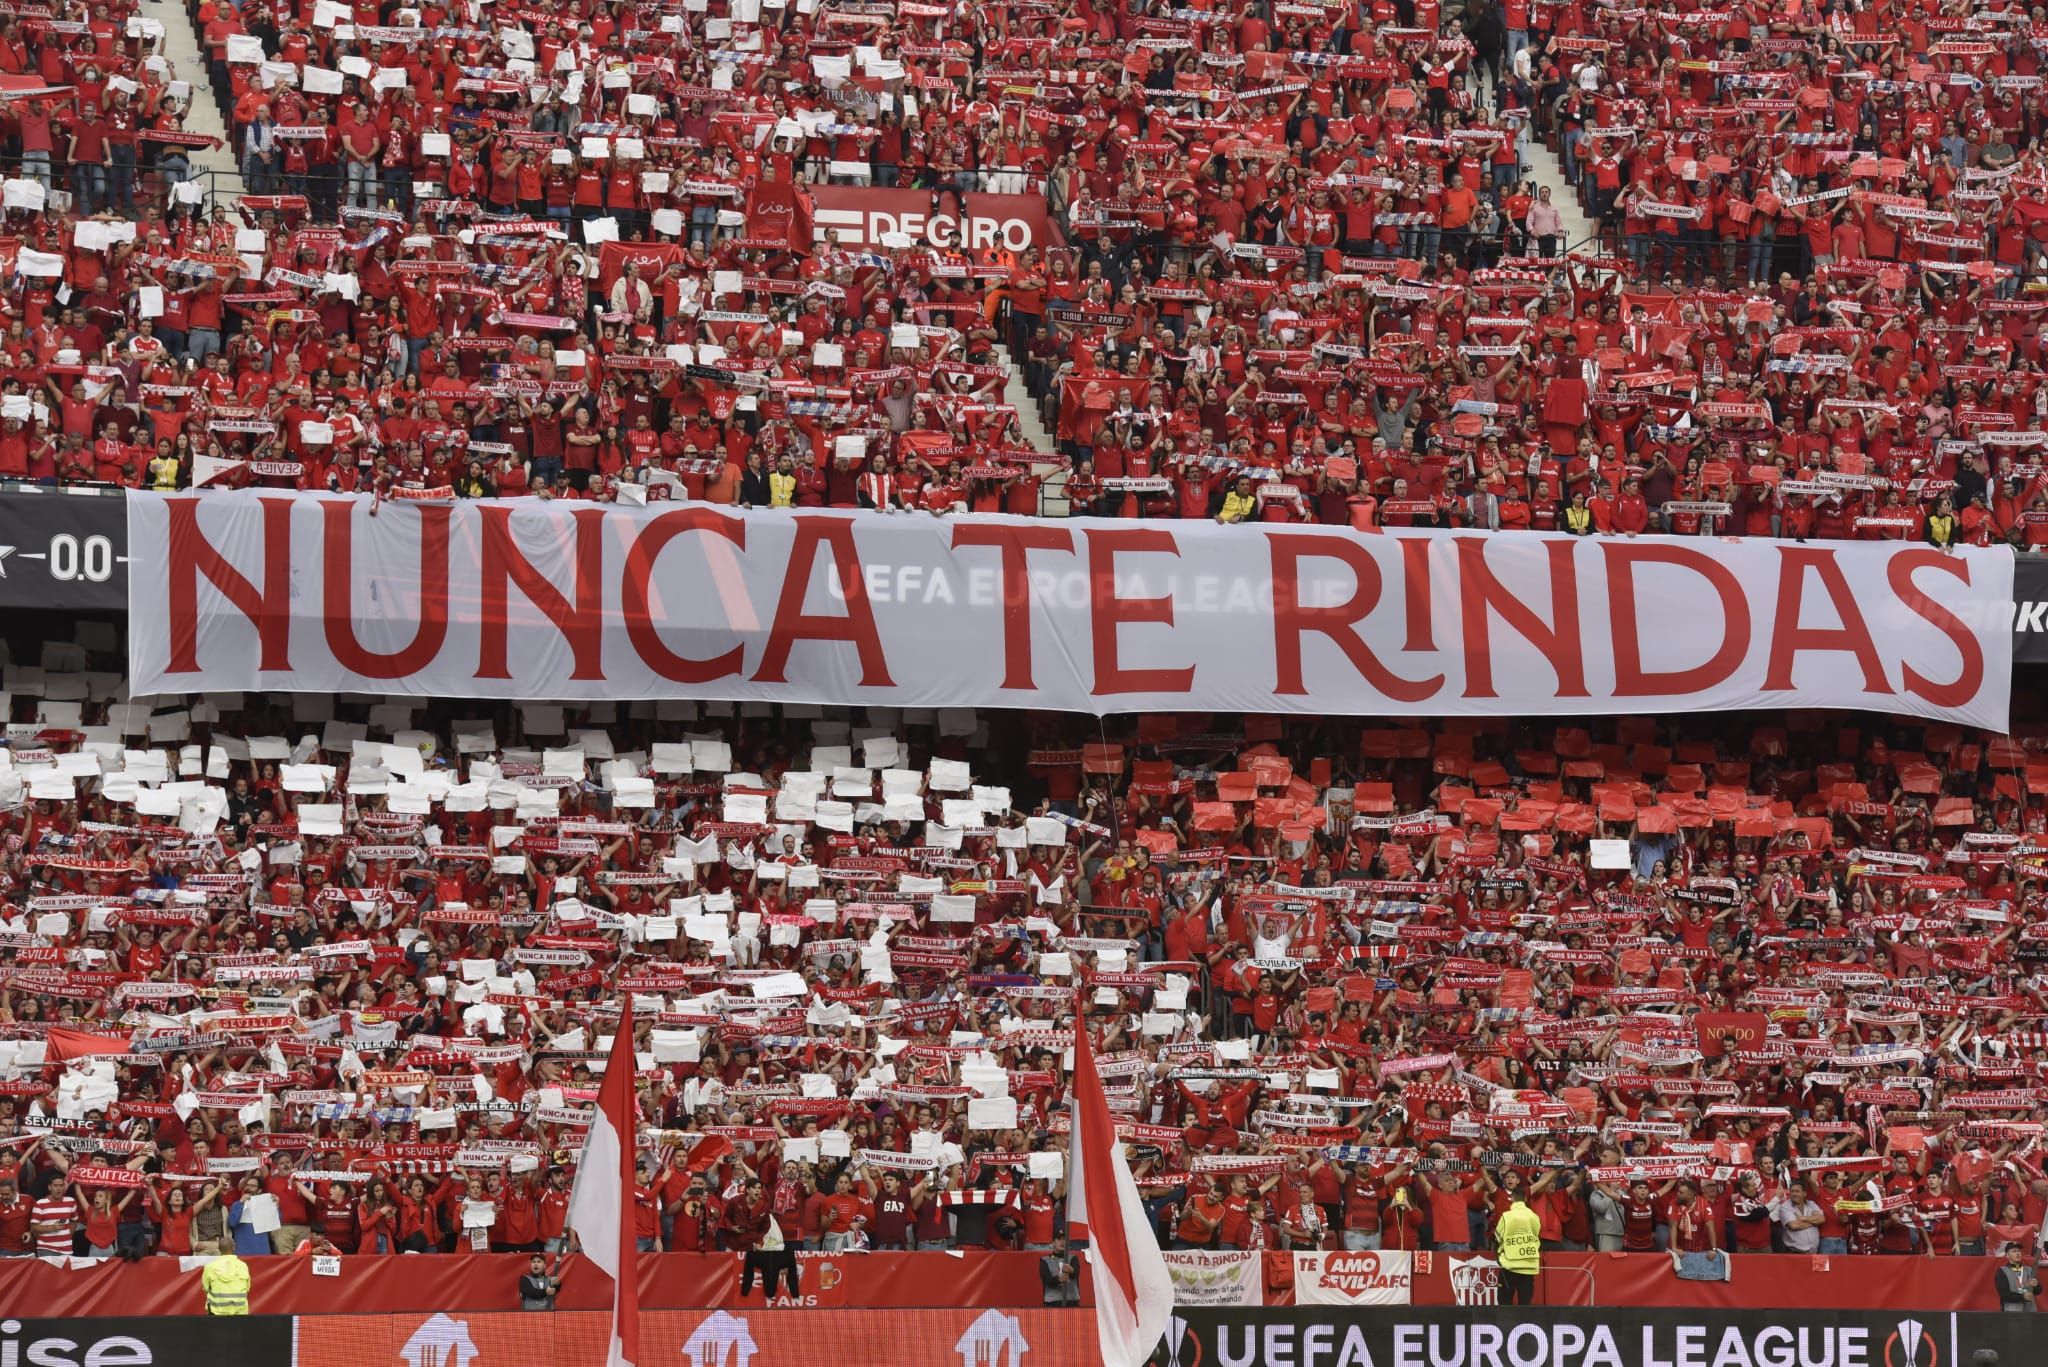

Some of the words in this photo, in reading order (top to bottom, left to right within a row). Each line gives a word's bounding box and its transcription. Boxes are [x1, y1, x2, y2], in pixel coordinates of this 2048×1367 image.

[520, 11, 559, 24] SEVILLA
[1657, 11, 1682, 21] FINAL
[1704, 13, 1731, 23] COPA
[1928, 20, 1958, 29] SEVILLA
[1899, 207, 1948, 218] SUPERCOPA
[869, 211, 1033, 252] DEGIRO
[288, 270, 318, 286] SEVILLA
[1828, 356, 1846, 364] RINDO
[1708, 405, 1742, 414] SEVILLA
[1745, 405, 1755, 414] FC
[1990, 433, 2014, 441] NUNCA
[485, 441, 505, 449] RINDO
[926, 447, 953, 455] SEVILLA
[954, 446, 965, 454] FC
[1107, 479, 1133, 488] NUNCA
[1134, 480, 1145, 488] ME
[1146, 480, 1167, 488] RINDO
[1820, 475, 1843, 484] NUNCA
[49, 532, 113, 581] 0.0
[827, 562, 954, 604] UEFA
[164, 497, 898, 688] NUNCA
[951, 523, 1197, 696] TE
[1262, 531, 1985, 709] RINDAS
[551, 778, 571, 786] RINDO
[1850, 802, 1888, 815] 1905
[1364, 817, 1388, 826] NUNCA
[1400, 813, 1421, 822] RINDO
[353, 847, 379, 856] NUNCA
[381, 847, 392, 856] ME
[393, 847, 416, 856] RINDO
[1897, 854, 1918, 863] RINDO
[1281, 885, 1304, 894] NUNCA
[1306, 886, 1316, 894] TE
[1501, 880, 1524, 889] FINAL
[867, 892, 895, 902] ULTRAS
[502, 913, 513, 922] ME
[590, 909, 602, 918] ME
[1577, 912, 1602, 921] NUNCA
[1604, 913, 1614, 921] TE
[1615, 912, 1638, 921] RINDAS
[1924, 919, 1952, 929] COPA
[329, 944, 340, 952] ME
[341, 943, 364, 951] RINDO
[16, 948, 59, 960] SEVILLA
[517, 952, 545, 962] NUNCA
[547, 954, 558, 962] ME
[559, 954, 581, 963] RINDO
[216, 956, 256, 967] SEVILLA
[1253, 958, 1287, 968] SEVILLA
[1289, 960, 1300, 969] FC
[72, 973, 103, 983] SEVILLA
[105, 974, 117, 983] FC
[239, 968, 251, 980] LA
[260, 970, 302, 980] PREVIA
[1914, 978, 1923, 986] ME
[826, 987, 857, 998] SEVILLA
[858, 988, 868, 997] FC
[728, 998, 756, 1006] NUNCA
[757, 998, 768, 1006] ME
[769, 998, 792, 1007] RINDO
[222, 1018, 273, 1028] SEVILLA
[1737, 1028, 1756, 1042] DO
[147, 1037, 179, 1048] DNIPRO
[188, 1034, 220, 1045] SEVILLA
[1624, 1042, 1649, 1056] VAMOS
[1663, 1048, 1681, 1059] COPA
[121, 1055, 133, 1063] ME
[134, 1055, 159, 1063] RINDO
[1844, 1054, 1878, 1065] SEVILLA
[6, 1082, 17, 1090] TE
[1461, 1074, 1488, 1090] NUNCA
[1662, 1081, 1690, 1092] BIRIS
[1701, 1082, 1733, 1093] NORTE
[25, 1115, 75, 1129] SEVILLA
[77, 1119, 95, 1129] FC
[1264, 1111, 1292, 1122] NUNCA
[1294, 1114, 1305, 1123] ME
[1306, 1115, 1330, 1124] RINDO
[1419, 1122, 1441, 1130] SEVILLA
[1641, 1123, 1653, 1132] ME
[1654, 1125, 1679, 1133] RINDO
[103, 1141, 133, 1151] SEVILLA
[273, 1139, 298, 1147] SEVILLA
[483, 1140, 513, 1148] NUNCA
[514, 1141, 526, 1149] ME
[865, 1152, 893, 1162] NUNCA
[895, 1155, 907, 1163] ME
[908, 1156, 933, 1166] RINDO
[1630, 1158, 1655, 1167] RINDO
[1599, 1168, 1625, 1179] SEVILLA
[884, 1200, 905, 1212] GAP
[1519, 1247, 1537, 1257] 069
[319, 1258, 333, 1267] JUVE
[1196, 1256, 1211, 1267] TE
[1212, 1251, 1253, 1267] RINDAS
[1299, 1257, 1318, 1272] TE
[1330, 1257, 1377, 1274] AMO
[316, 1265, 335, 1275] MERDA
[1318, 1274, 1390, 1290] SEVILLA
[766, 1294, 818, 1308] FANS
[0, 1319, 153, 1367] ise
[1216, 1323, 1373, 1367] UEFA
[1392, 1323, 1624, 1367] EUROPA
[1641, 1323, 1870, 1367] LEAGUE
